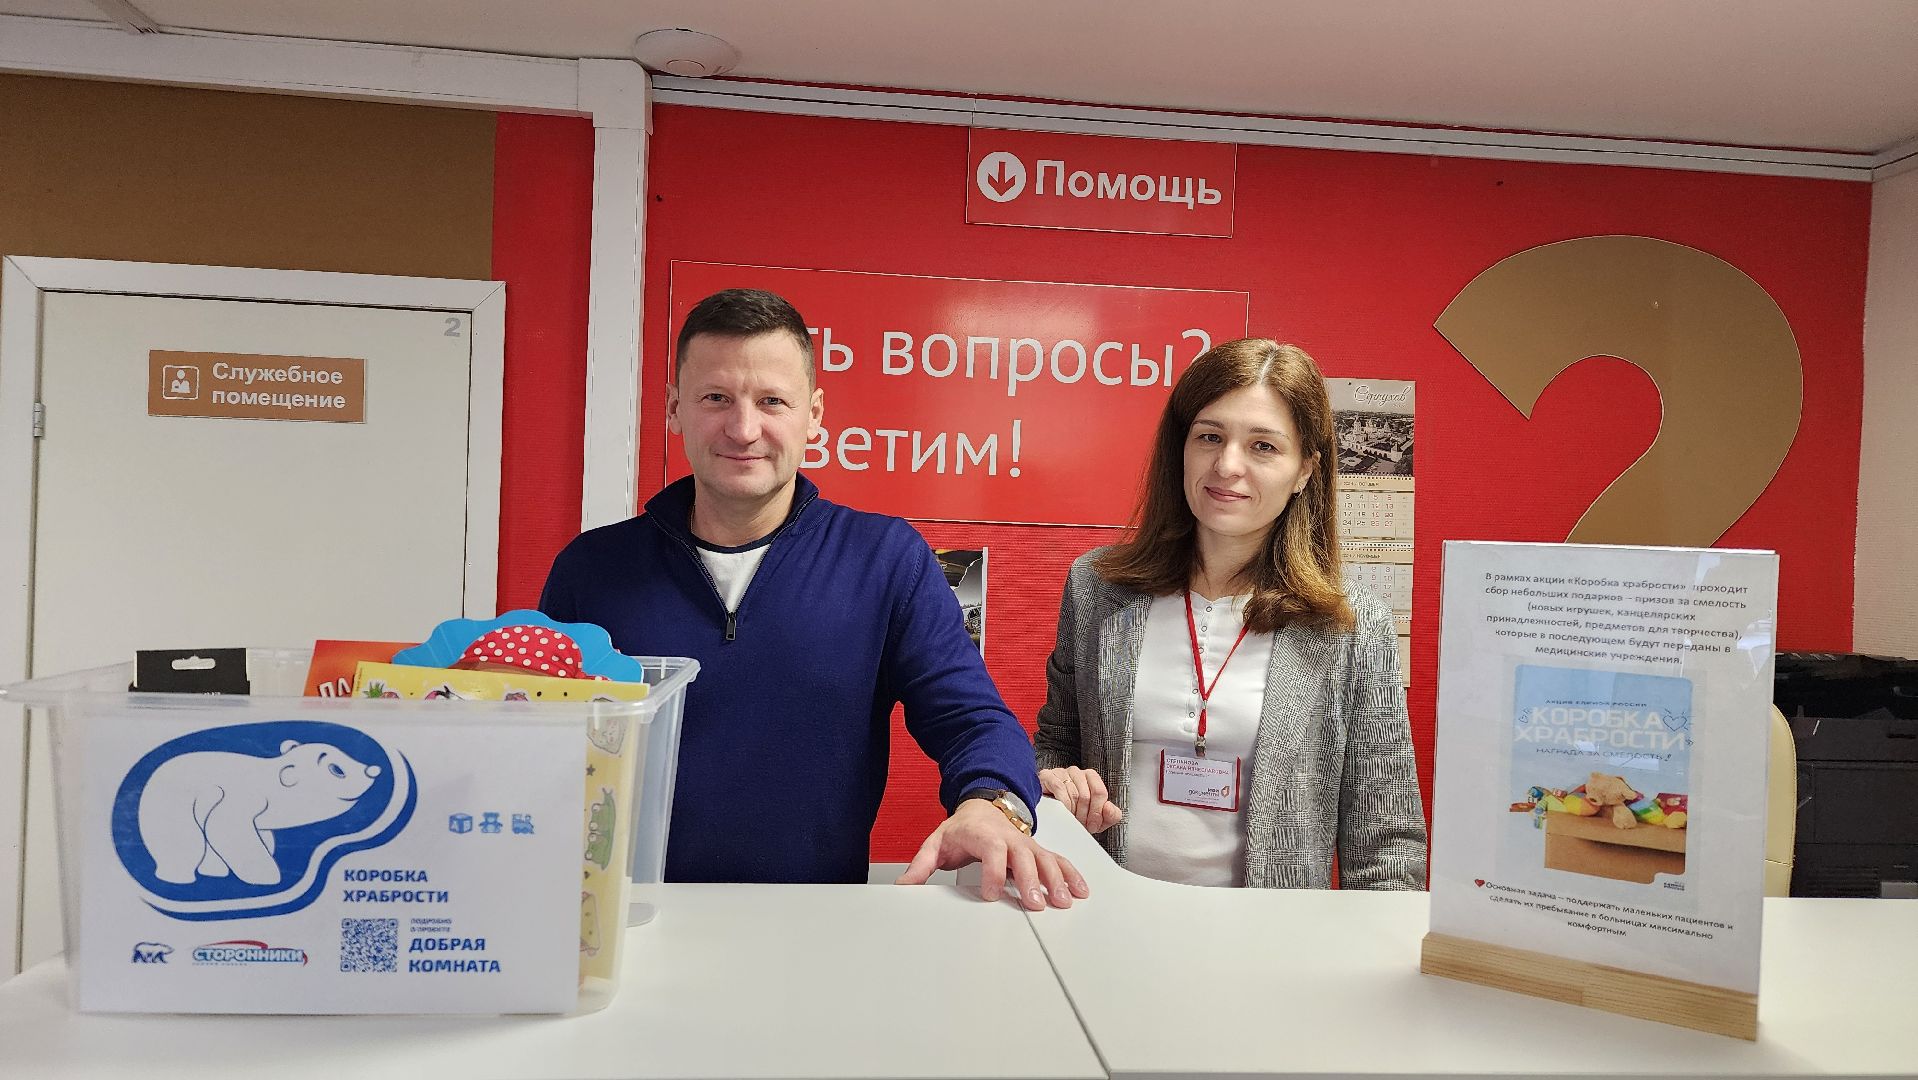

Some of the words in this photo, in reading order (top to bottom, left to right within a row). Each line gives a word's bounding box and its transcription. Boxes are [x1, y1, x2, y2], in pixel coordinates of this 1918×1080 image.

[1035, 159, 1222, 211] Помощь
[444, 317, 461, 337] 2
[882, 328, 1212, 397] вопросы?
[212, 361, 344, 385] Служебное
[212, 386, 346, 410] помещение
[1485, 572, 1492, 581] В
[1494, 573, 1531, 582] рамках
[1533, 575, 1565, 584] акции
[1485, 586, 1509, 596] сбор
[1511, 588, 1569, 598] небольших
[1571, 591, 1623, 601] подарков
[1635, 596, 1674, 605] призов
[1678, 598, 1690, 606] за
[1693, 599, 1746, 609] смелость
[1527, 602, 1563, 612] (новых
[1566, 606, 1614, 616] игрушек,
[1617, 609, 1696, 621] канцелярских
[1486, 615, 1582, 629] принадлежностей,
[1585, 621, 1645, 632] предметов
[1648, 626, 1669, 635] для
[1495, 629, 1538, 639] которые
[1549, 633, 1626, 645] последующем
[1629, 637, 1661, 648] будут
[1662, 642, 1721, 653] переданы
[1610, 652, 1683, 664] учреждения.
[1531, 706, 1665, 730] КОРОБКА
[1514, 726, 1685, 750] ХРАБРОСТИ
[1536, 748, 1584, 756] НАГРАДА
[344, 869, 428, 883] КОРОБКА
[343, 889, 448, 903] ХРАБРОСТИ
[1485, 882, 1526, 894] Основная
[1528, 890, 1557, 900] задача
[1566, 896, 1621, 911] поддержать
[1622, 906, 1673, 920] маленьких
[1675, 914, 1725, 929] пациентов
[1489, 895, 1522, 906] сделать
[1535, 903, 1590, 919] пребывание
[1598, 913, 1647, 928] больницах
[1648, 922, 1713, 940] максимально
[1567, 921, 1627, 937] комфортным
[192, 948, 304, 963] СТОРОННИКИ
[408, 938, 486, 953] ДОБРАЯ
[408, 959, 501, 973] КОМНАТА
